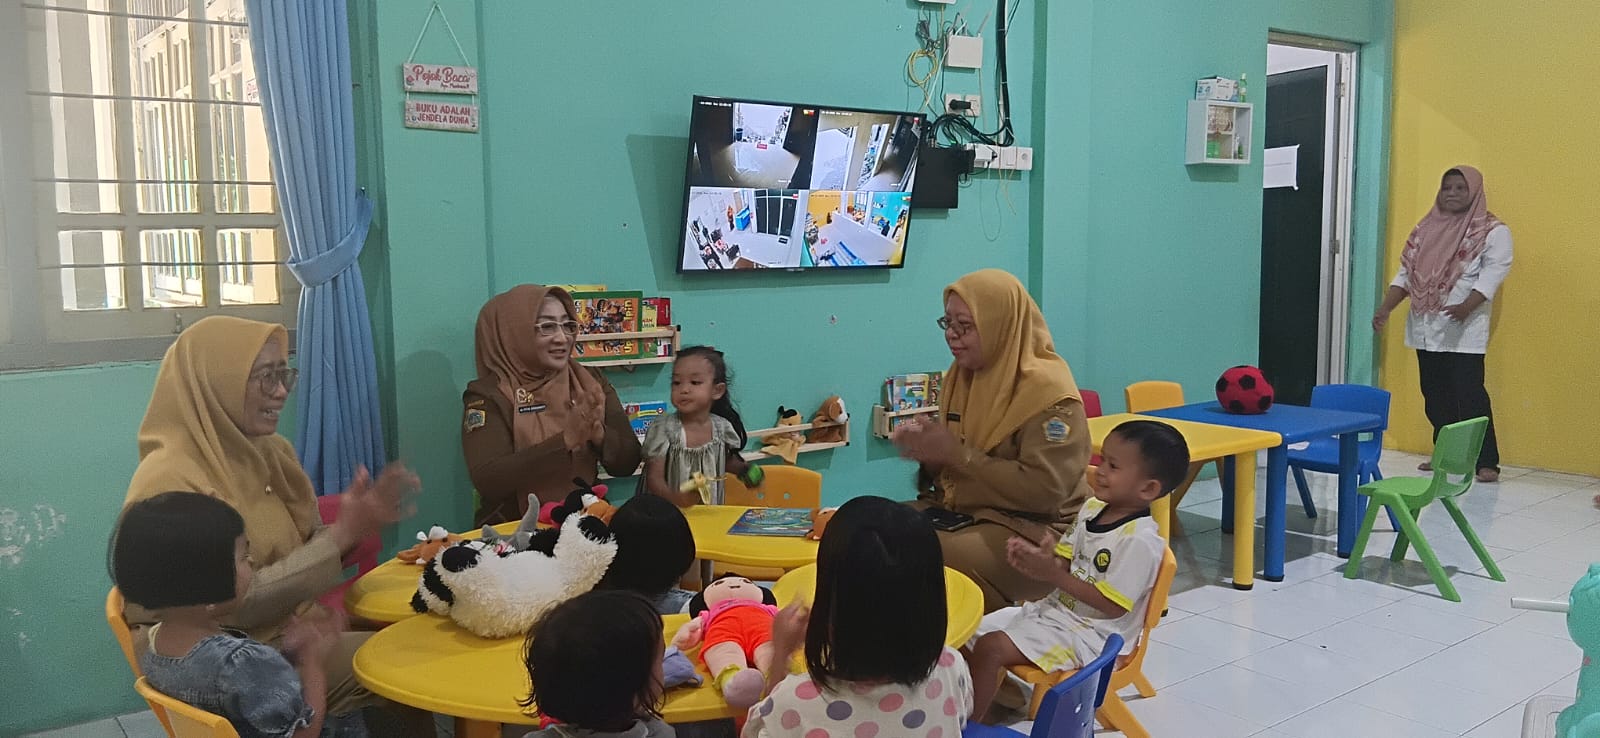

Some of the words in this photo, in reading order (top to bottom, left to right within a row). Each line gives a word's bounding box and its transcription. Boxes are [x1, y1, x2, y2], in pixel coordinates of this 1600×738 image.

[413, 65, 441, 85] Pojok
[442, 68, 470, 83] Baca
[416, 103, 437, 113] BUKU
[441, 106, 470, 116] ADALAH
[418, 114, 448, 123] JENDELA
[449, 116, 469, 125] DUNIA
[624, 299, 634, 321] Ipin
